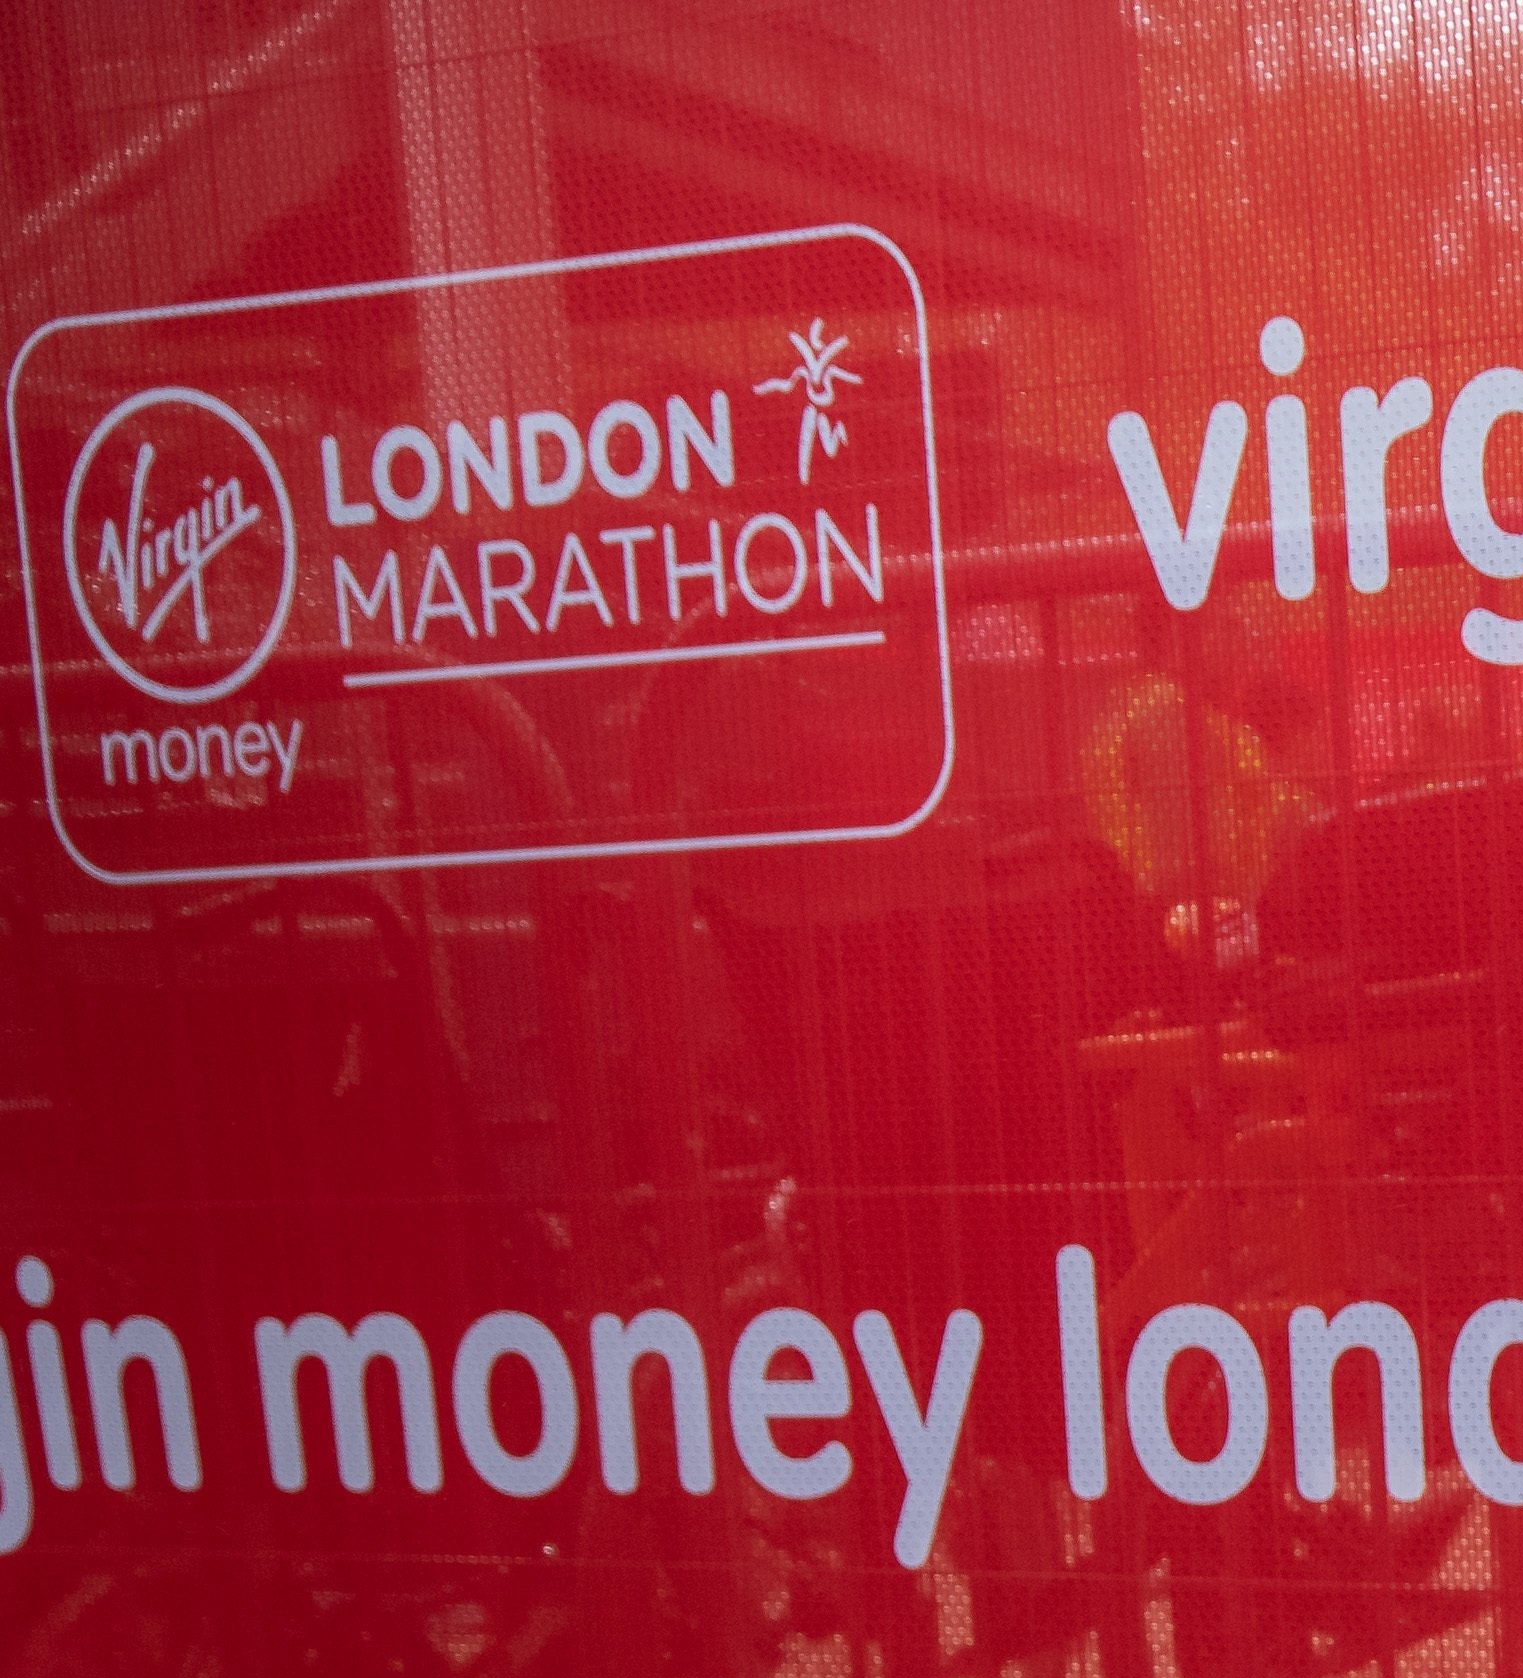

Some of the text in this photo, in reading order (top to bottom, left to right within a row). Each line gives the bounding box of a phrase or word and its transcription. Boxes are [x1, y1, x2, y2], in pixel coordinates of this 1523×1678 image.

[322, 391, 737, 527] LONDON
[99, 442, 261, 643] Virgin
[333, 503, 885, 648] MARATHON
[101, 720, 303, 793] money
[254, 1306, 984, 1569] money
